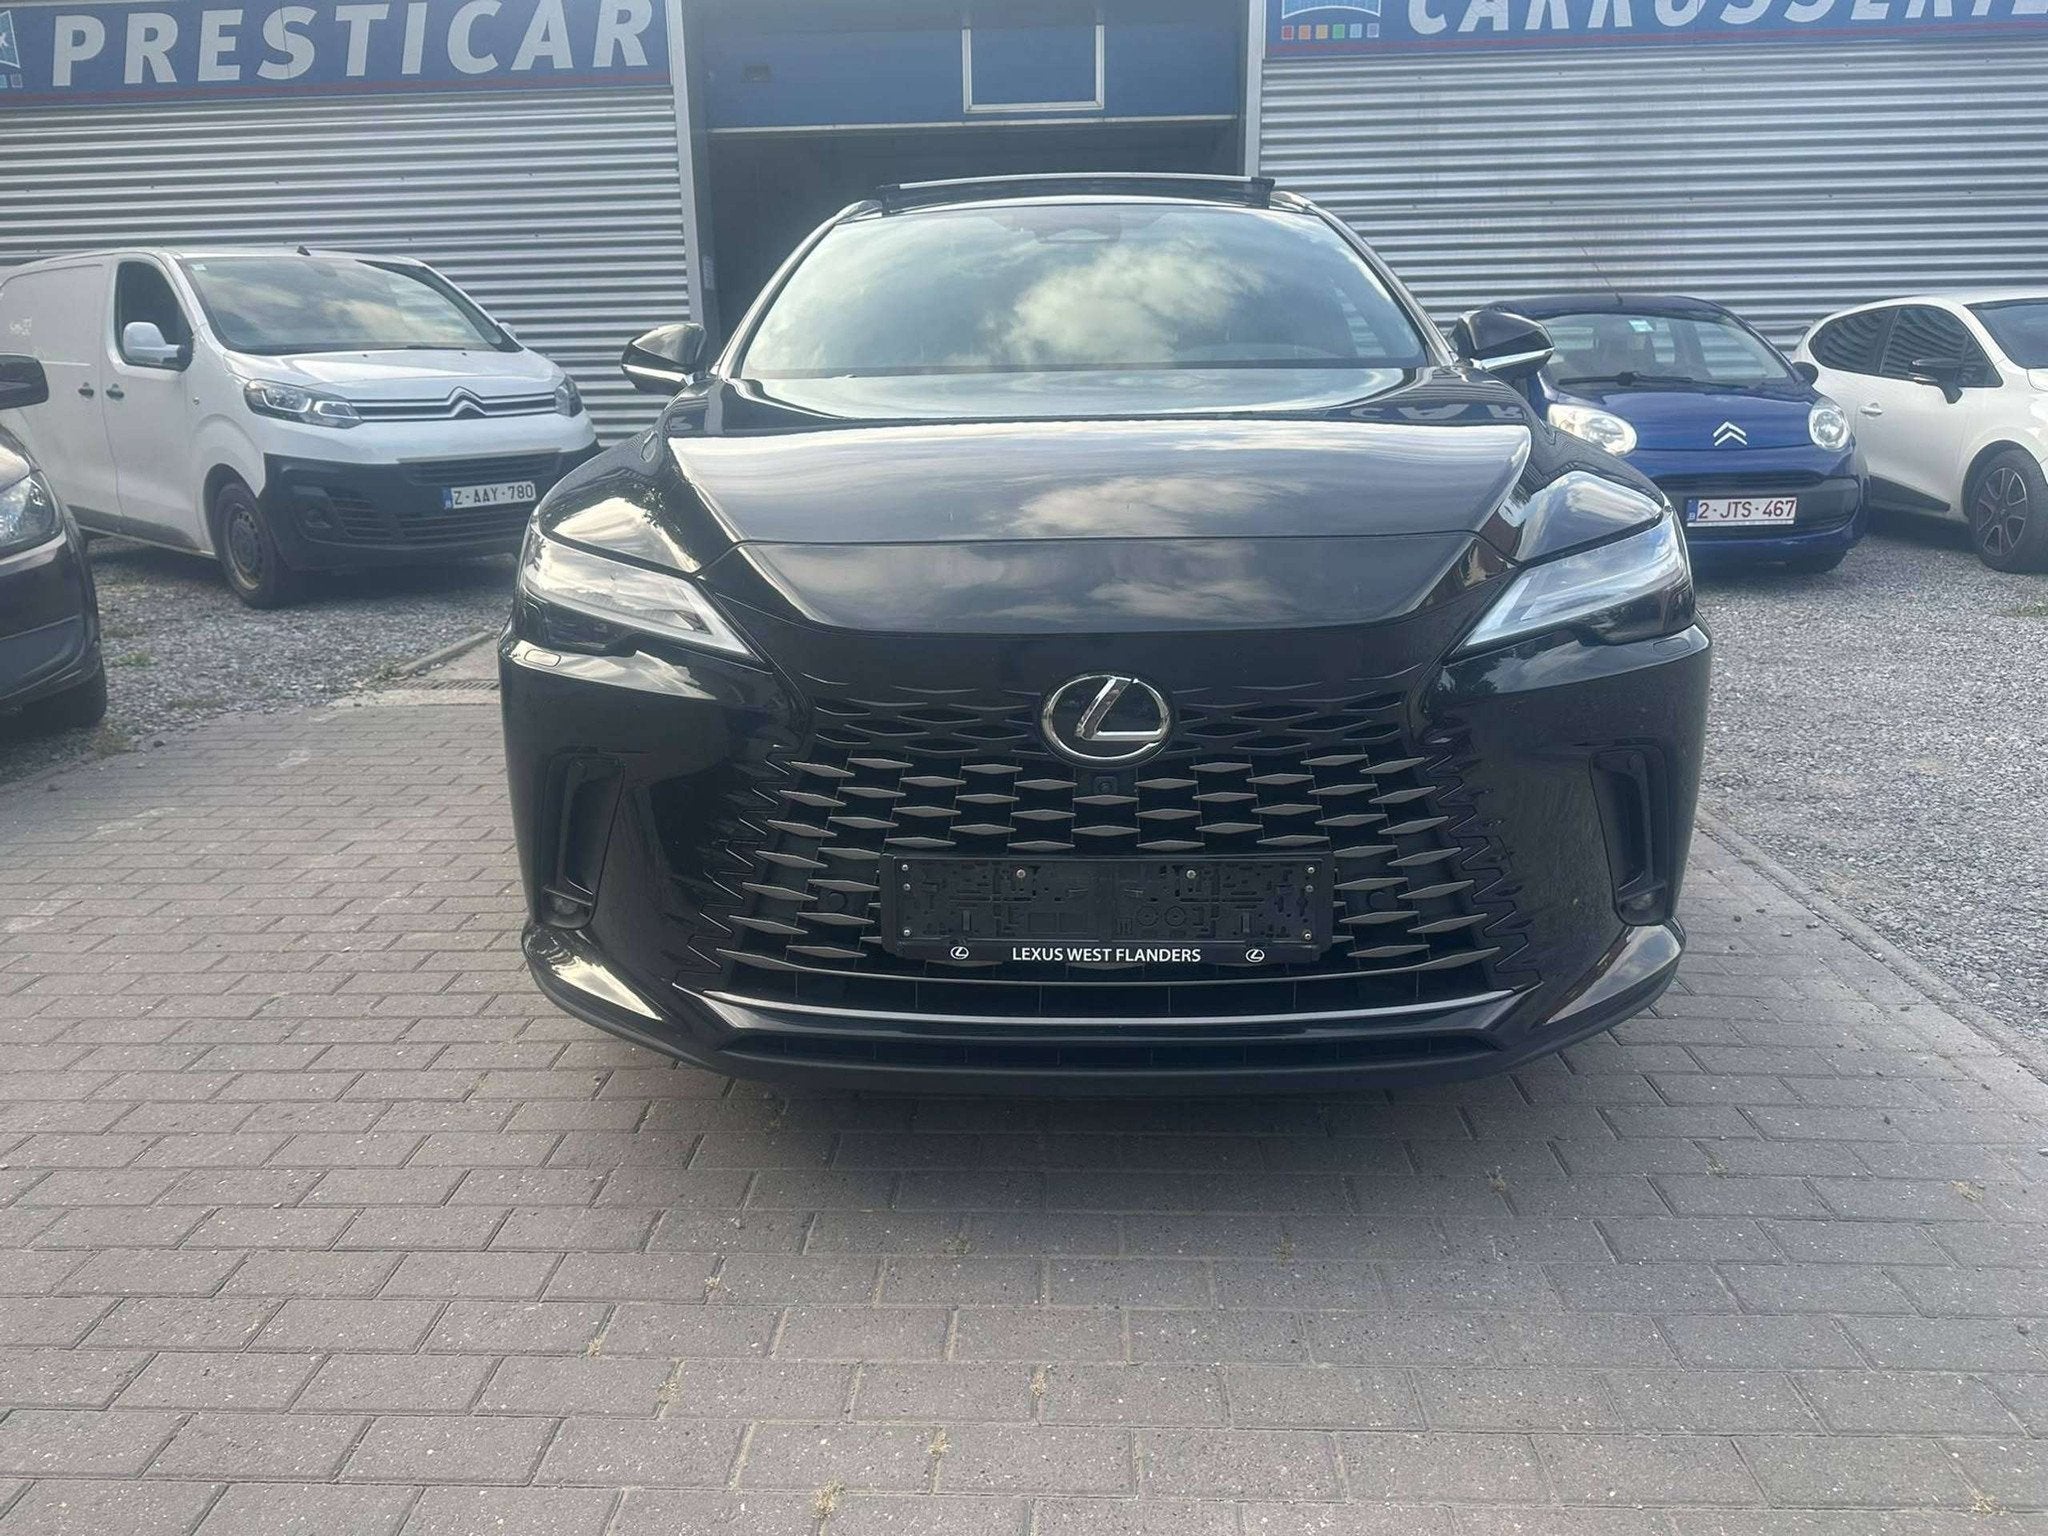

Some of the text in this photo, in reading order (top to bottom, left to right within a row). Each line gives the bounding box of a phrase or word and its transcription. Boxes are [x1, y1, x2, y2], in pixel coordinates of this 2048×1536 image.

[52, 0, 651, 87] PRESTICAR
[1698, 500, 1796, 519] 2-JTS-467
[1012, 947, 1201, 963] LEXUS WEST FLANDERS
